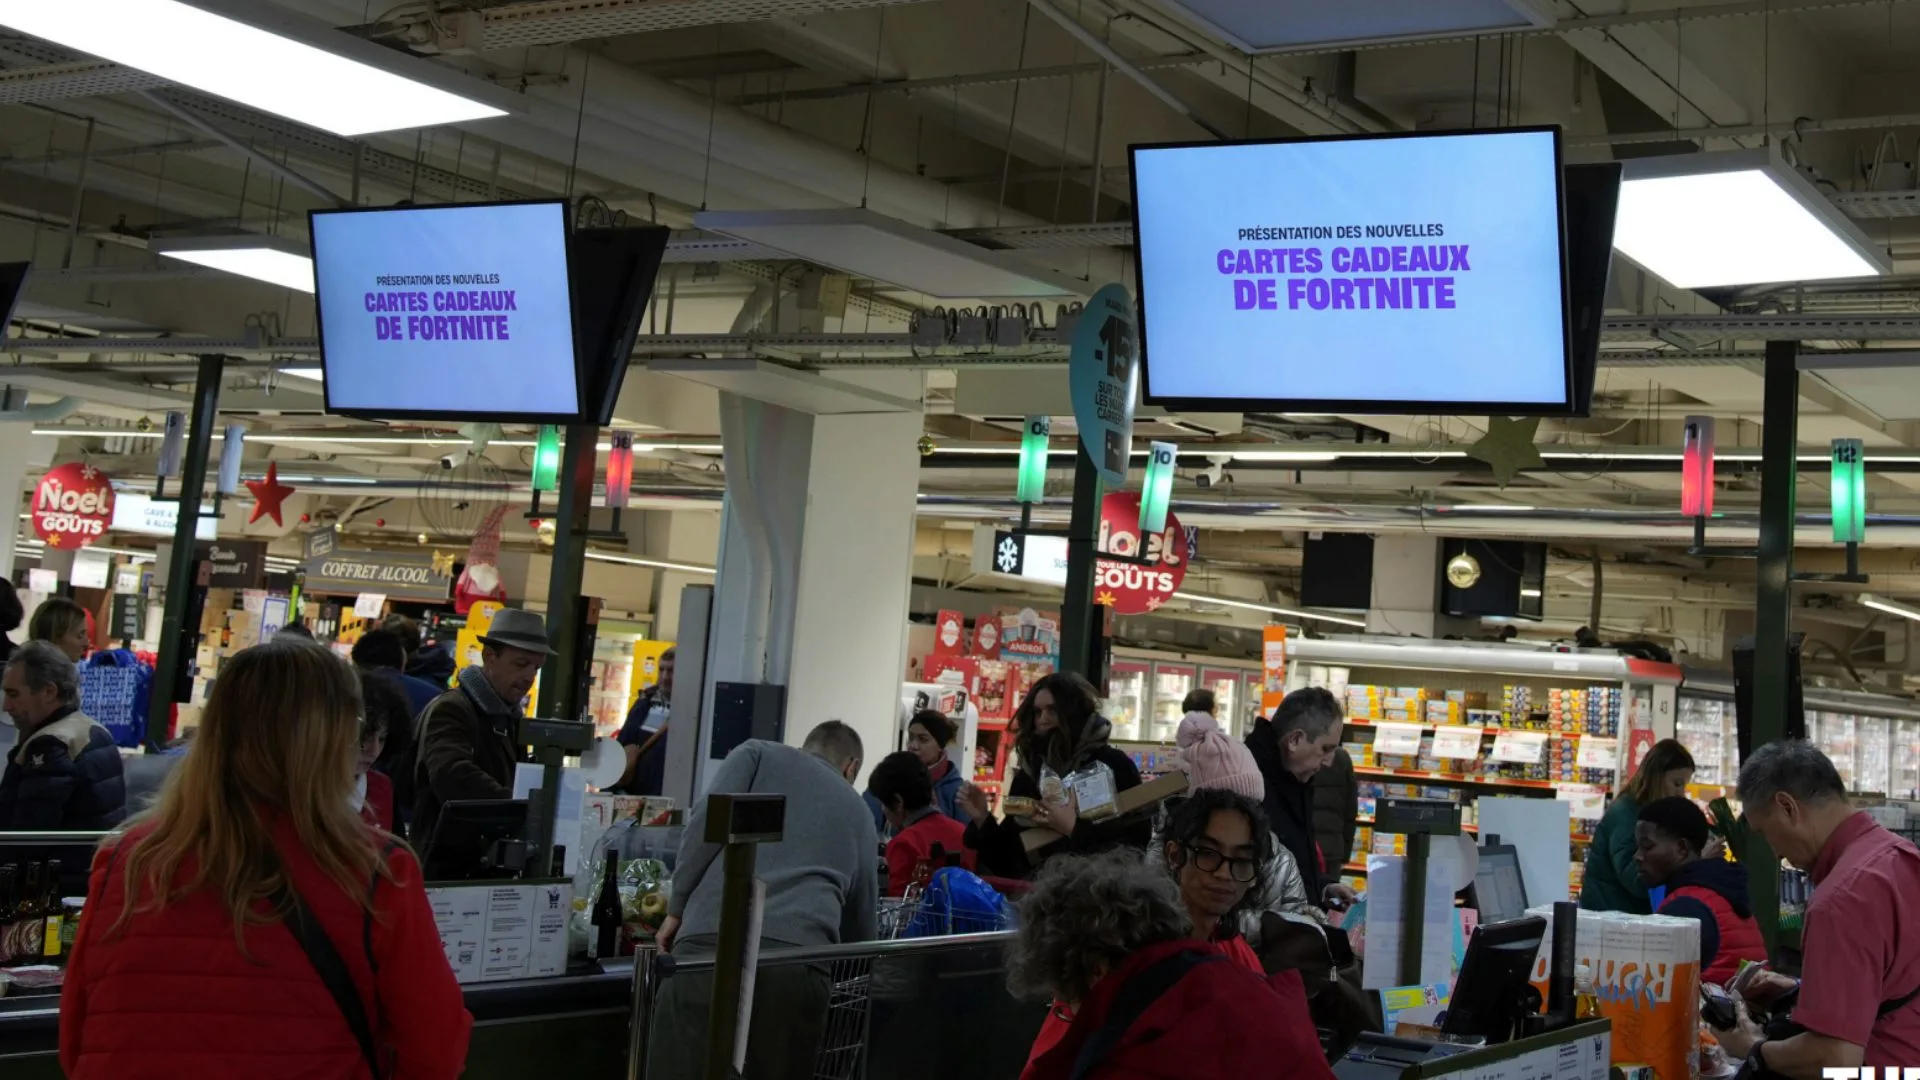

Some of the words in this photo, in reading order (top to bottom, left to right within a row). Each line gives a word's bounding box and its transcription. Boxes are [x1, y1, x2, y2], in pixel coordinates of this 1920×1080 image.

[1238, 225, 1332, 241] PRÉSENTATION
[1336, 226, 1362, 239] DES
[1366, 223, 1444, 238] NOUVELLES
[1217, 248, 1323, 274] CARTES
[1331, 245, 1471, 273] CADEAUX
[377, 274, 433, 286] PRÉSENTATION
[436, 275, 451, 285] DES
[453, 274, 500, 285] NOUVELLES
[365, 292, 428, 312] CARTES
[434, 291, 517, 311] CADEAUX
[1234, 279, 1277, 310] DE
[1287, 277, 1456, 310] FORTNITE
[375, 317, 403, 340] DE
[408, 315, 510, 340] FORTNITE
[1154, 450, 1171, 465] 10
[1834, 447, 1856, 463] 12
[42, 515, 103, 535] GOÛTS
[321, 561, 378, 580] COFFRET
[378, 564, 429, 584] ALCOOL
[1008, 642, 1044, 653] ANDROS
